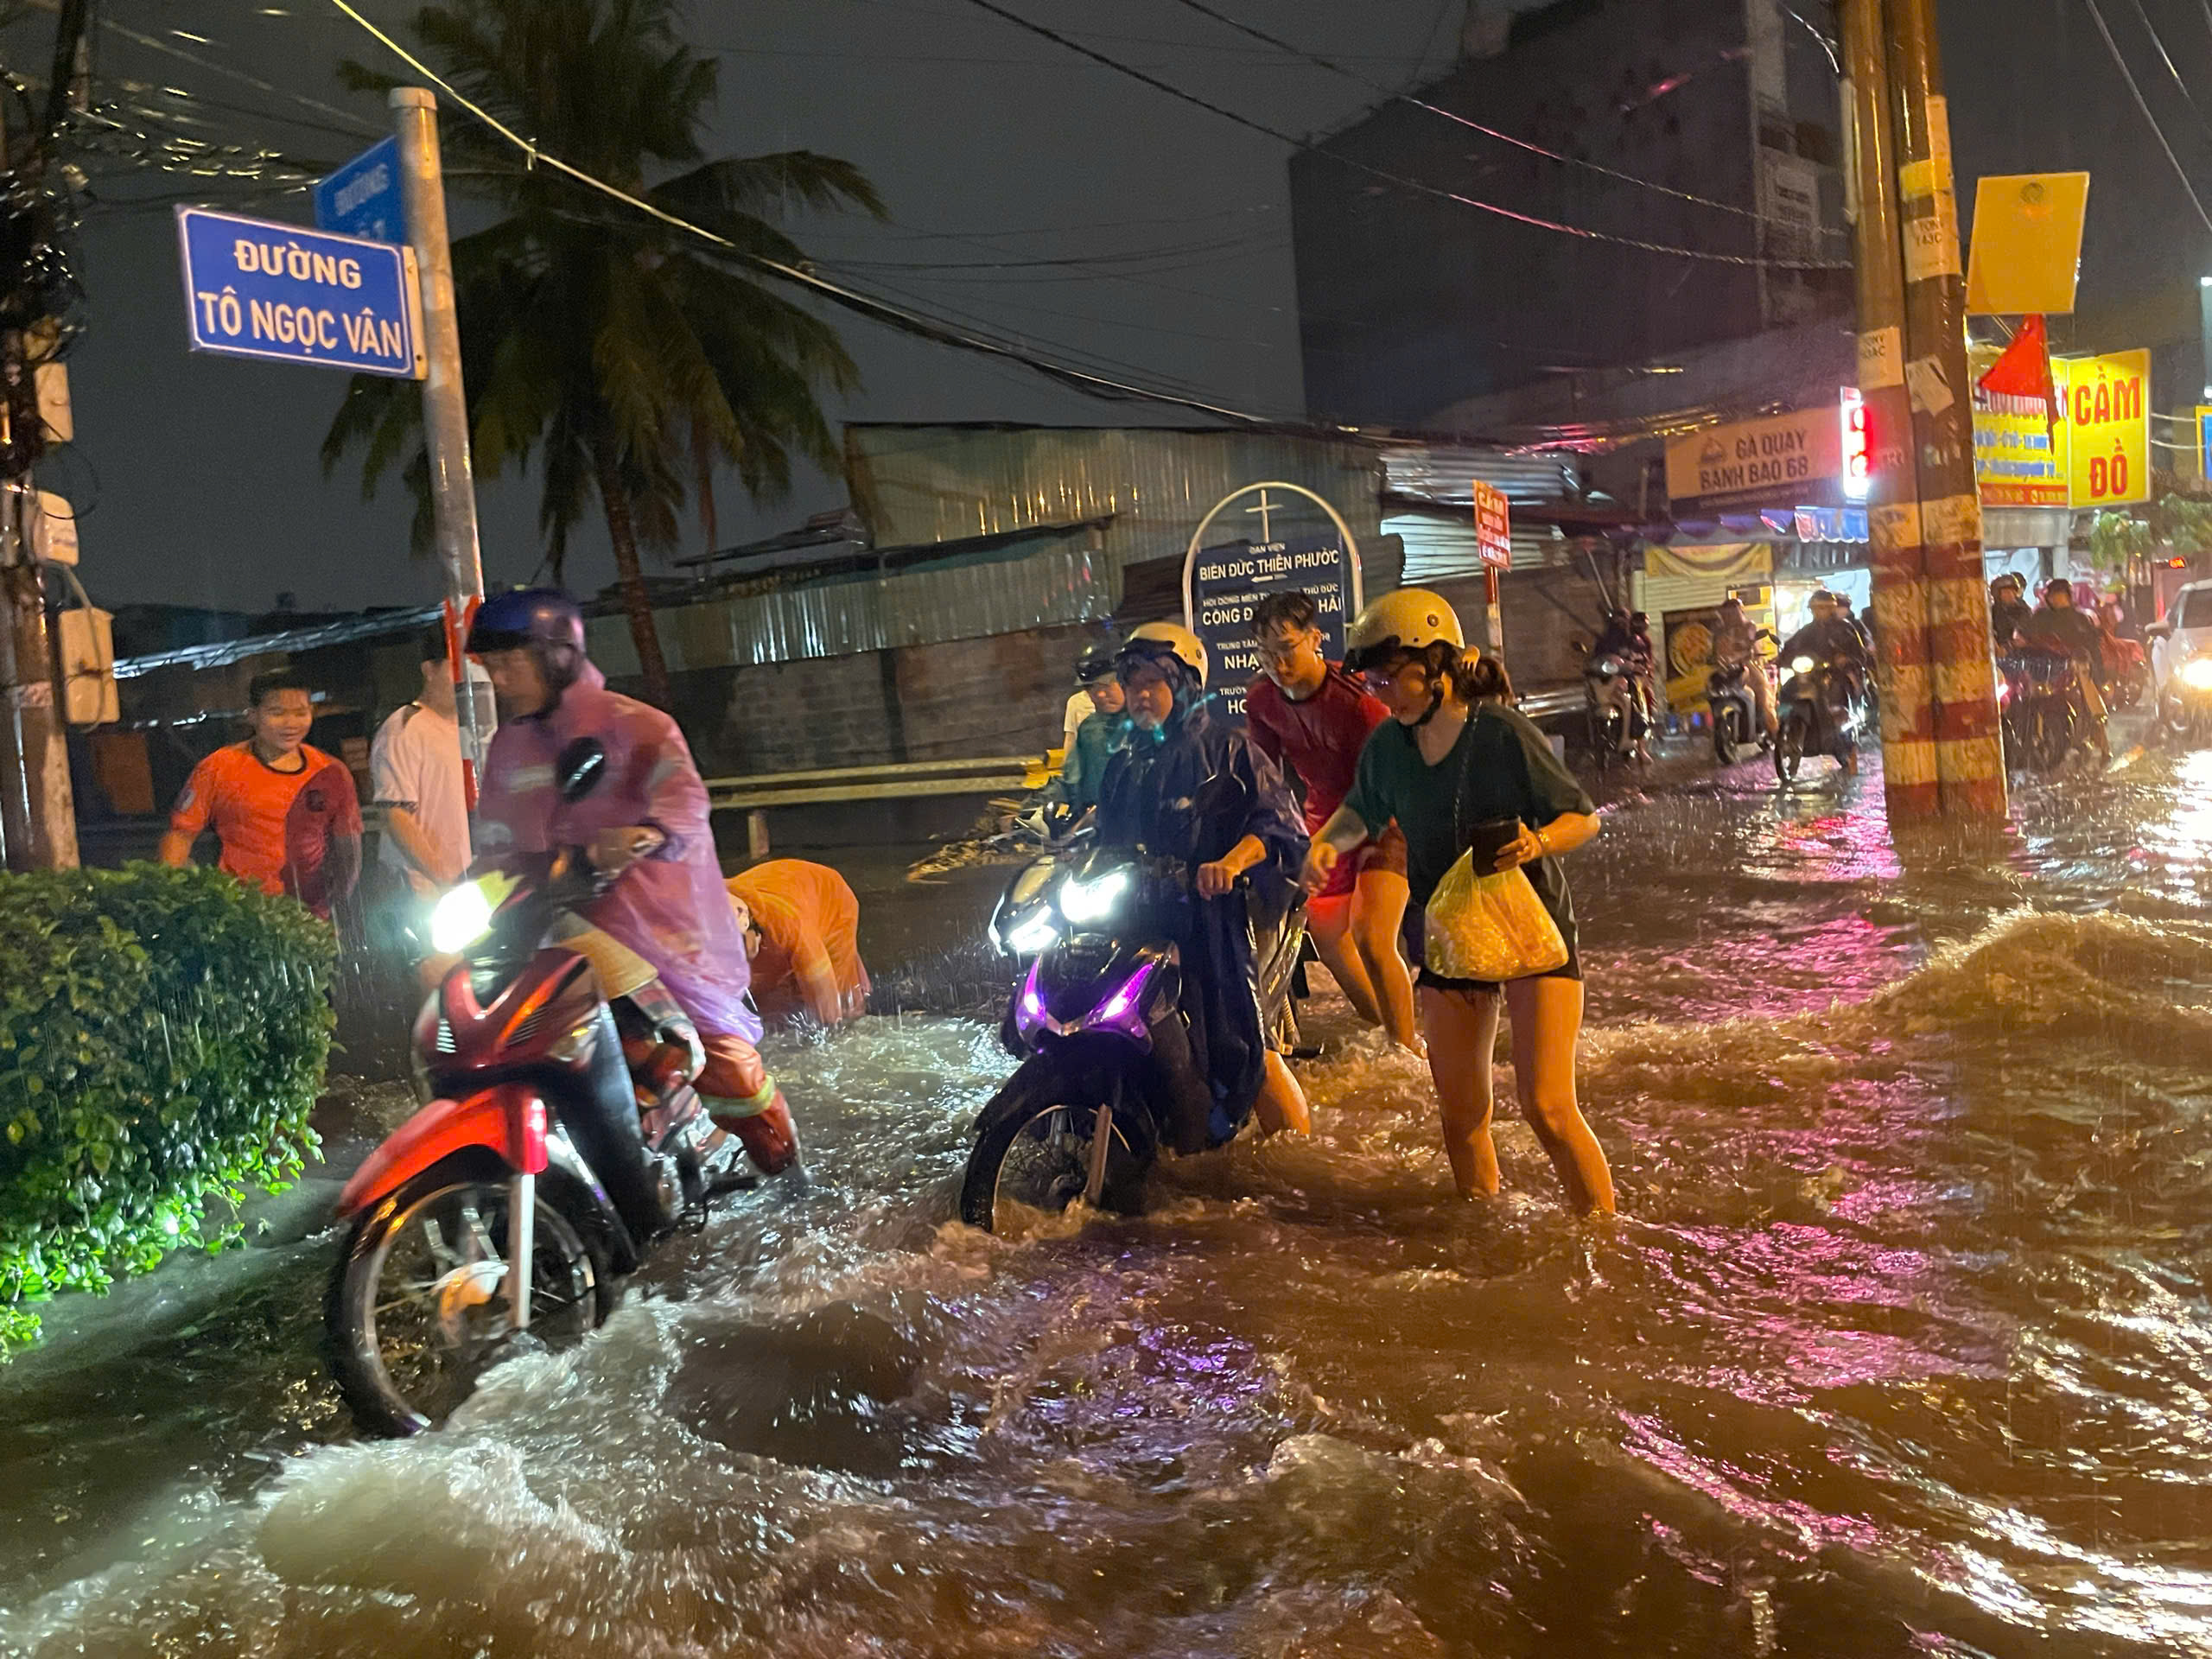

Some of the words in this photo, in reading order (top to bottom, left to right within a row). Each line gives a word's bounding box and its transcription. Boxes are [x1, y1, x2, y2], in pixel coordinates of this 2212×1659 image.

[233, 239, 362, 289] ĐƯỜNG
[197, 285, 242, 336] TÔ
[250, 299, 338, 353] NGỌC
[342, 307, 404, 359] VÂN
[2075, 365, 2140, 427] CẦM
[1762, 429, 1806, 456] QUAY
[1786, 455, 1808, 478] 68
[2089, 437, 2127, 498] ĐỒ
[1256, 554, 1293, 574] THIÊN
